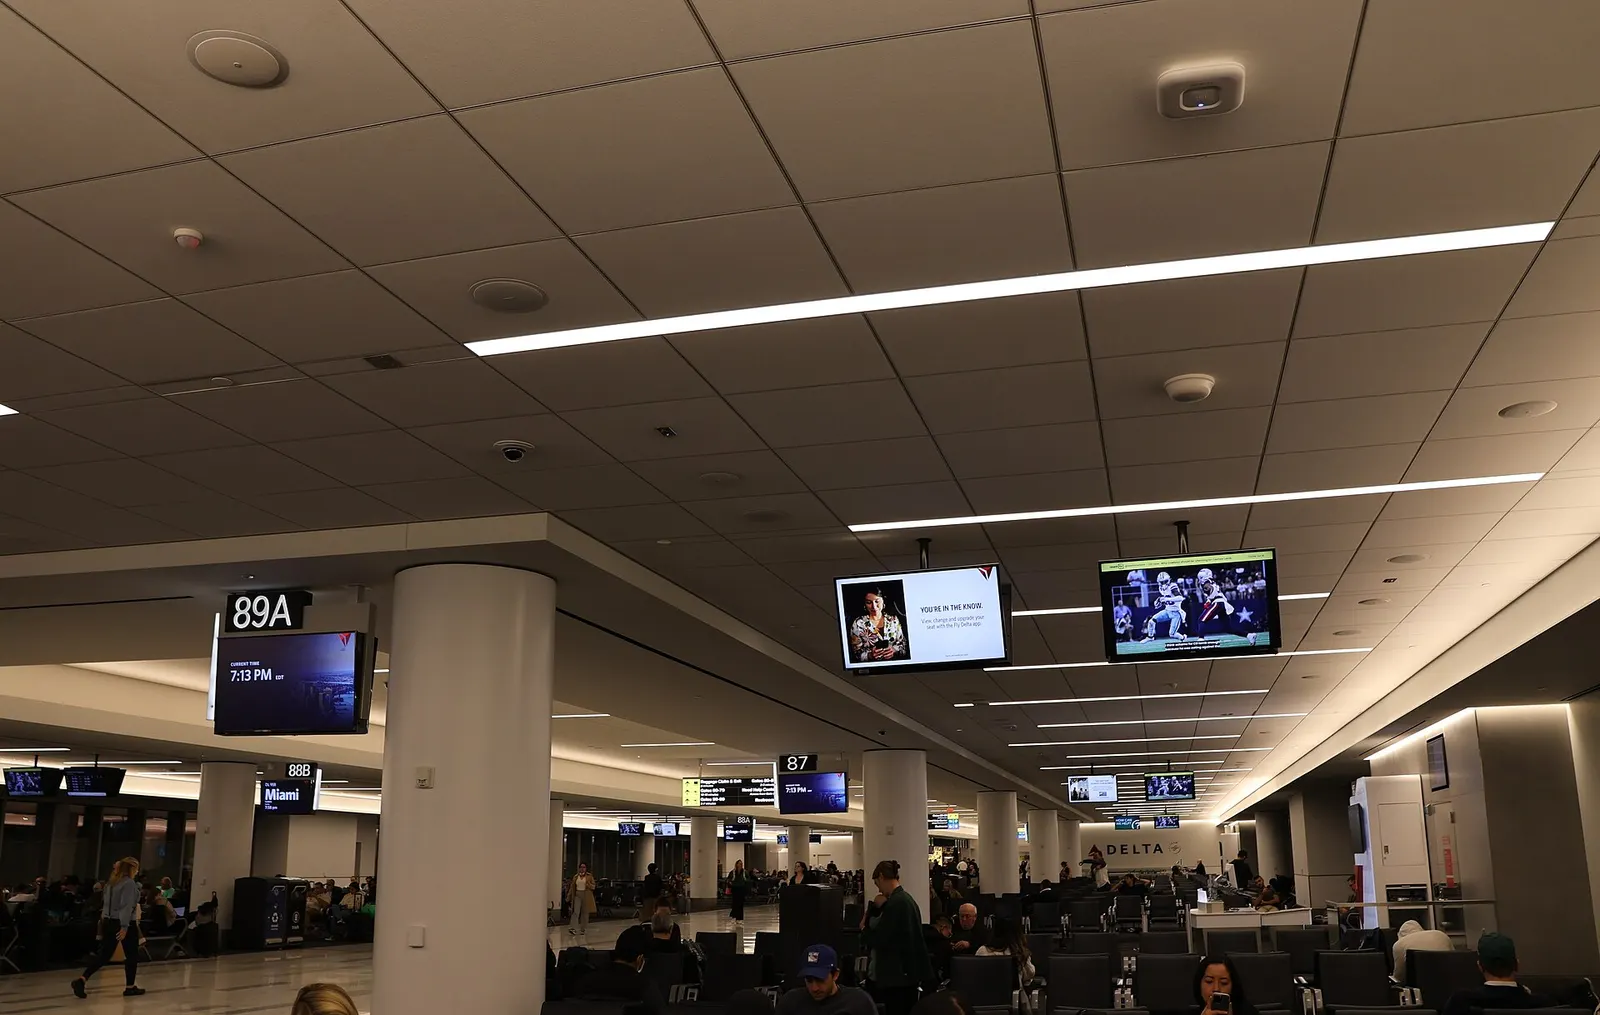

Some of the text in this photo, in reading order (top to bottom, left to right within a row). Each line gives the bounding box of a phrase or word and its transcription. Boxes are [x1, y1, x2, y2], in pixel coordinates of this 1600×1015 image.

[233, 594, 292, 629] 89A
[230, 670, 251, 681] 7:13
[254, 668, 272, 681] PM
[787, 756, 808, 770] 87
[289, 764, 310, 776] 88B
[265, 788, 299, 800] Miami
[1107, 844, 1163, 855] DELTA
